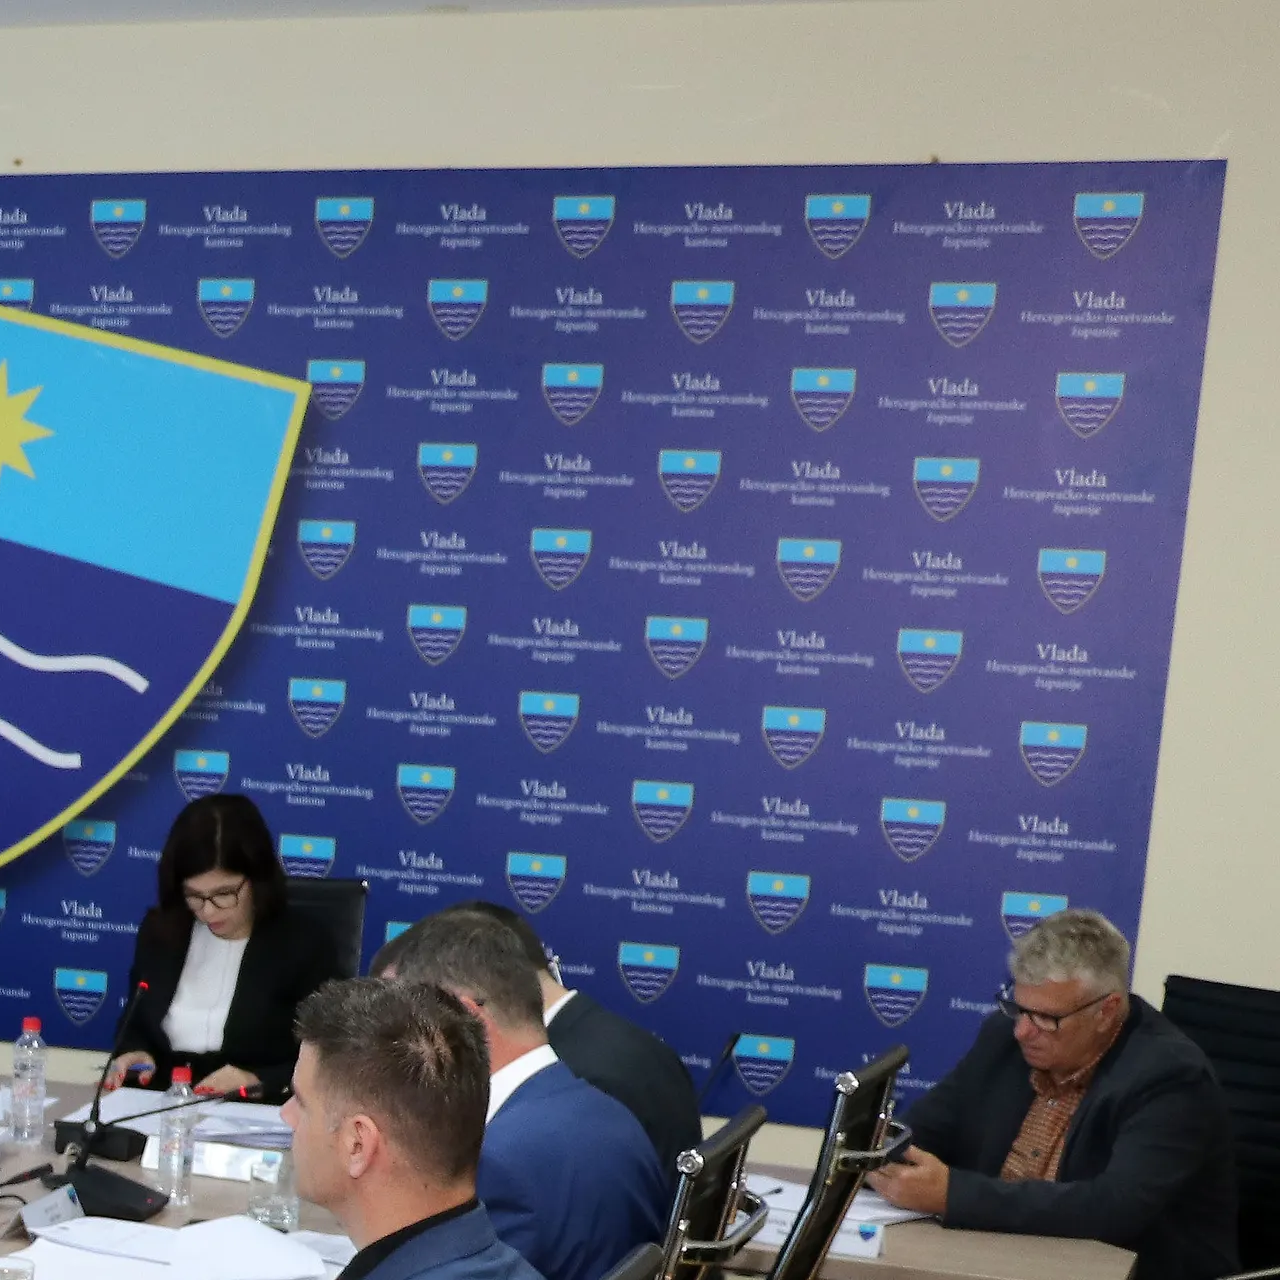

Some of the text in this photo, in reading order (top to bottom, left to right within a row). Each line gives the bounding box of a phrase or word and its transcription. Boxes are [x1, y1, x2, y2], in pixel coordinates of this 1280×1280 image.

[204, 205, 248, 222] Vlada
[441, 203, 487, 221] Vlada
[684, 203, 733, 220] Vlada
[944, 201, 996, 220] Vlada
[91, 285, 134, 302] Vlada
[314, 286, 359, 303] Vlada
[556, 287, 603, 305] Vlada
[805, 289, 856, 307] Vlada
[1073, 291, 1126, 309] Vlada
[431, 369, 477, 386] Vlada
[672, 373, 721, 391] Vlada
[928, 378, 979, 396] Vlada
[305, 447, 350, 465] Vlada
[545, 454, 592, 472] Vlada
[791, 461, 841, 479] Vlada
[1055, 469, 1107, 488] Vlada
[421, 532, 466, 549] Vlada
[659, 541, 707, 559] Vlada
[912, 551, 963, 570] Vlada
[296, 607, 340, 624] Vlada
[533, 618, 580, 636] Vlada
[777, 630, 826, 649] Vlada
[1037, 643, 1088, 663] Vlada
[410, 692, 455, 711] Vlada
[646, 707, 694, 725] Vlada
[896, 722, 946, 741] Vlada
[287, 764, 330, 782] Vlada
[521, 780, 567, 799] Vlada
[762, 797, 810, 817] Vlada
[1018, 815, 1069, 835] Vlada
[399, 851, 444, 870] Vlada
[632, 870, 679, 889] Vlada
[879, 890, 928, 909] Vlada
[62, 900, 103, 919] Vlada
[747, 961, 795, 981] Vlada
